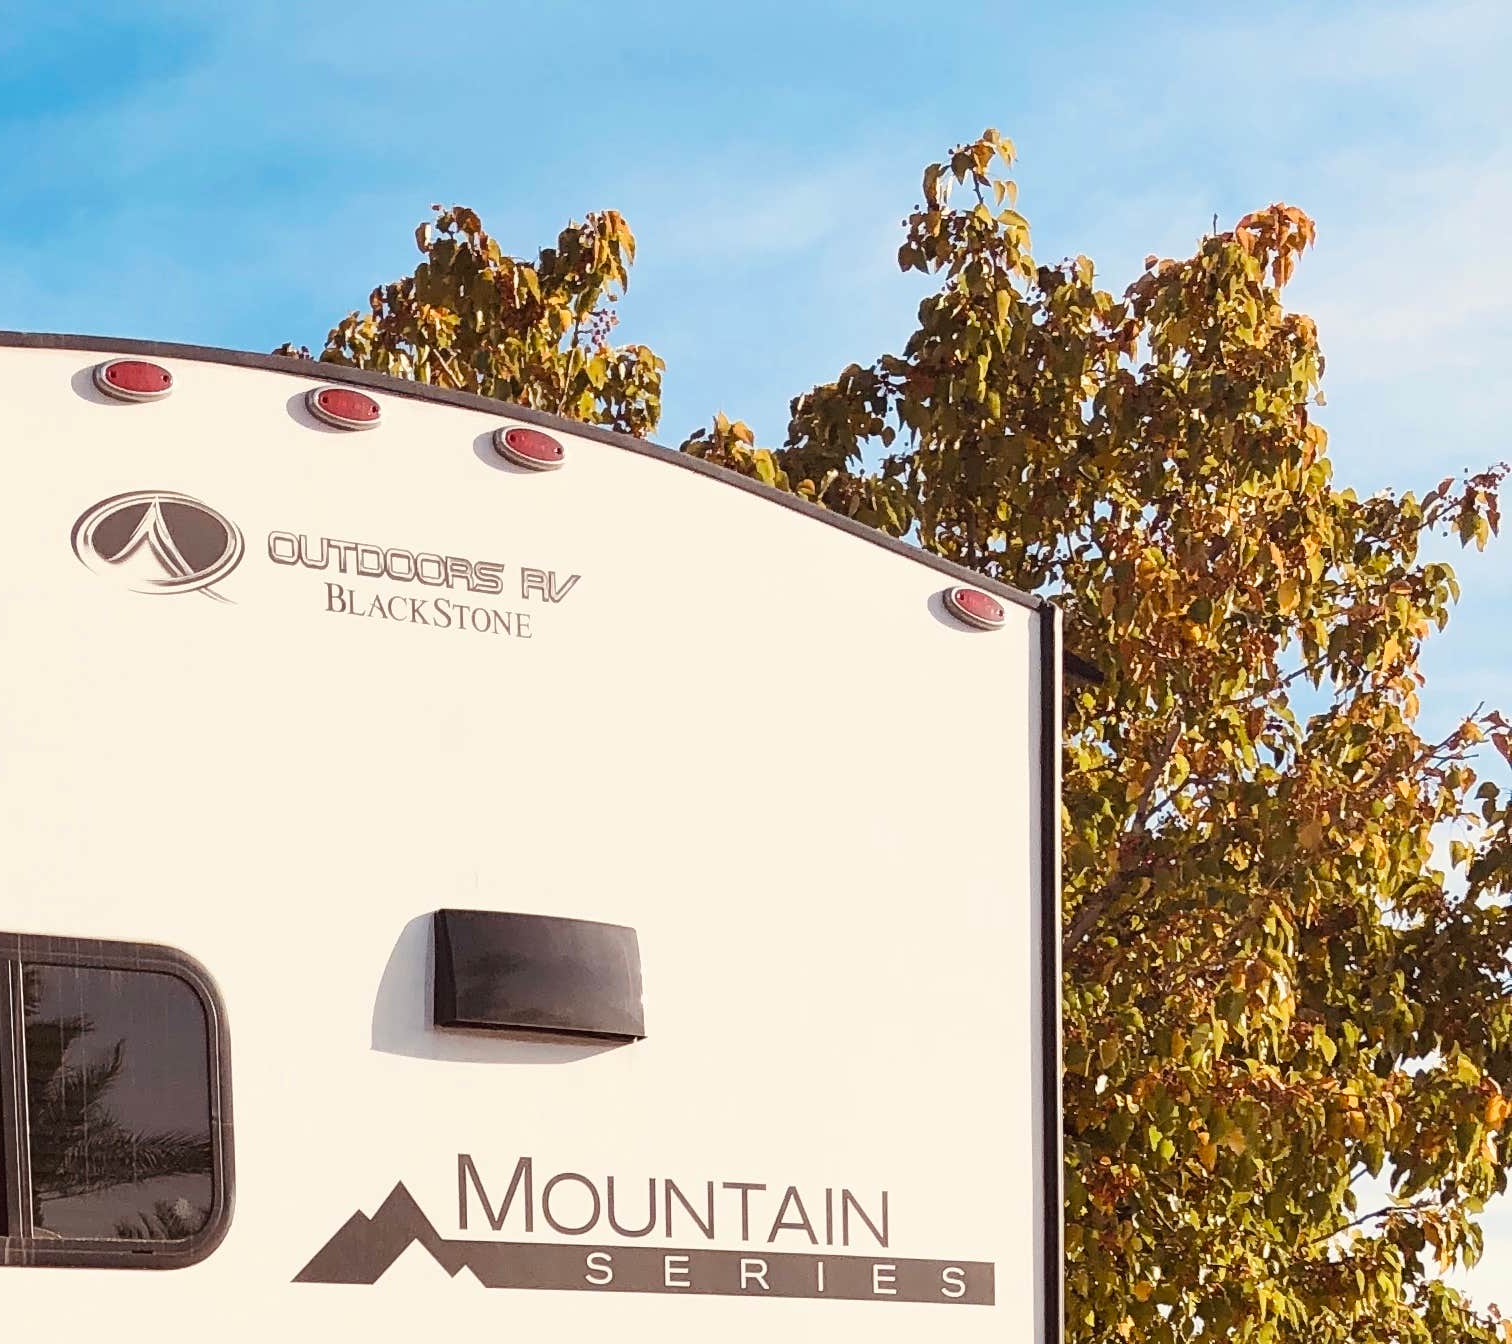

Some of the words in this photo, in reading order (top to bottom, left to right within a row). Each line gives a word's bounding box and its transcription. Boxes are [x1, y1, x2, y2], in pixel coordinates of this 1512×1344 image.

[267, 530, 504, 595] OUTDOORS
[521, 567, 582, 603] RV
[457, 1153, 889, 1249] MOUNTAIN
[586, 1252, 966, 1298] SERIES
